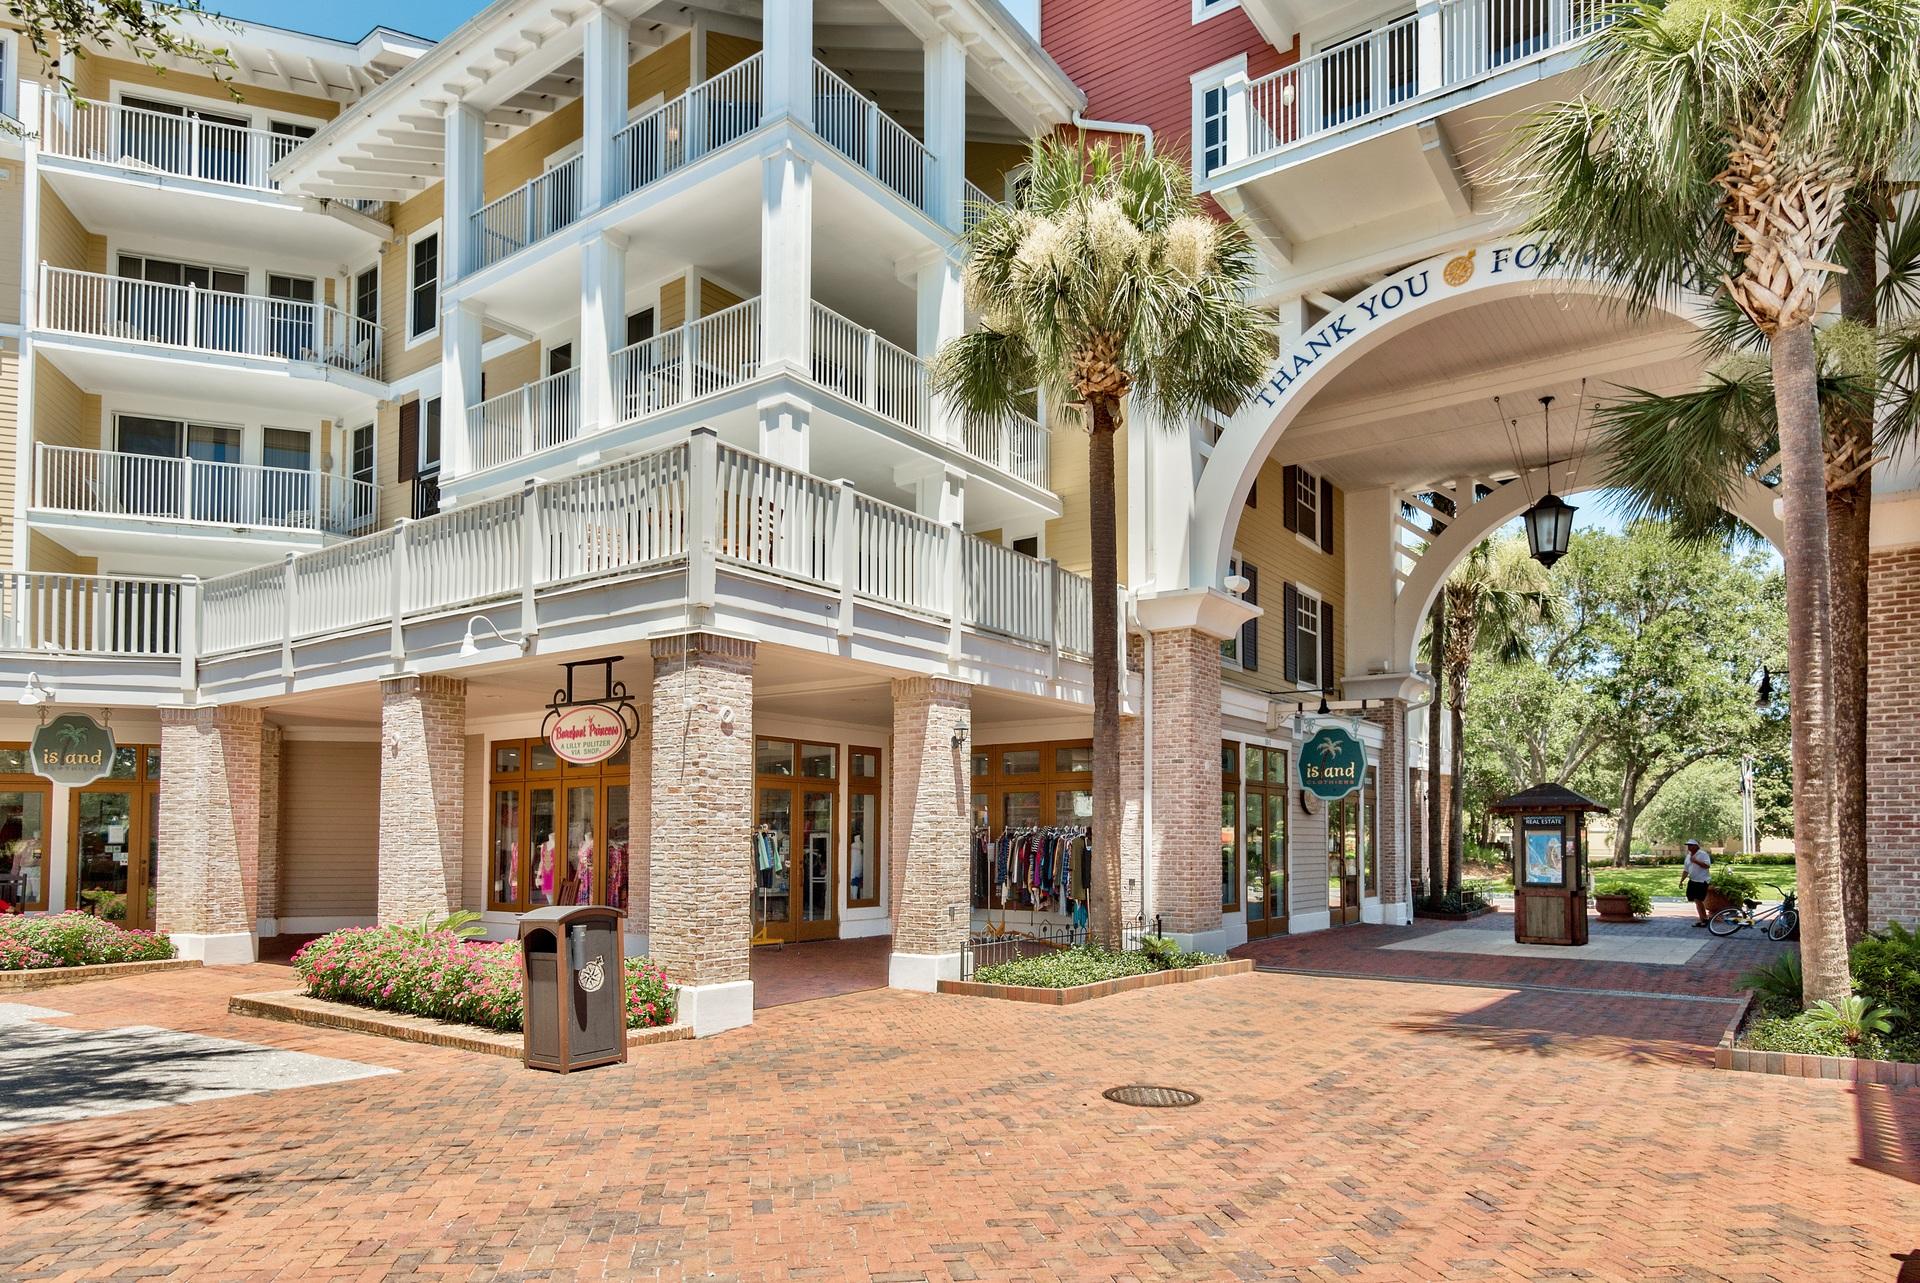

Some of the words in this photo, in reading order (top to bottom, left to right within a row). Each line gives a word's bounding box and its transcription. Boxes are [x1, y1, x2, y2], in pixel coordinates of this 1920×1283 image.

[1255, 314, 1356, 409] THANK
[1357, 270, 1429, 321] YOU
[556, 725, 586, 740] Barefoot
[589, 722, 619, 738] Princess
[583, 740, 611, 748] PULITZER
